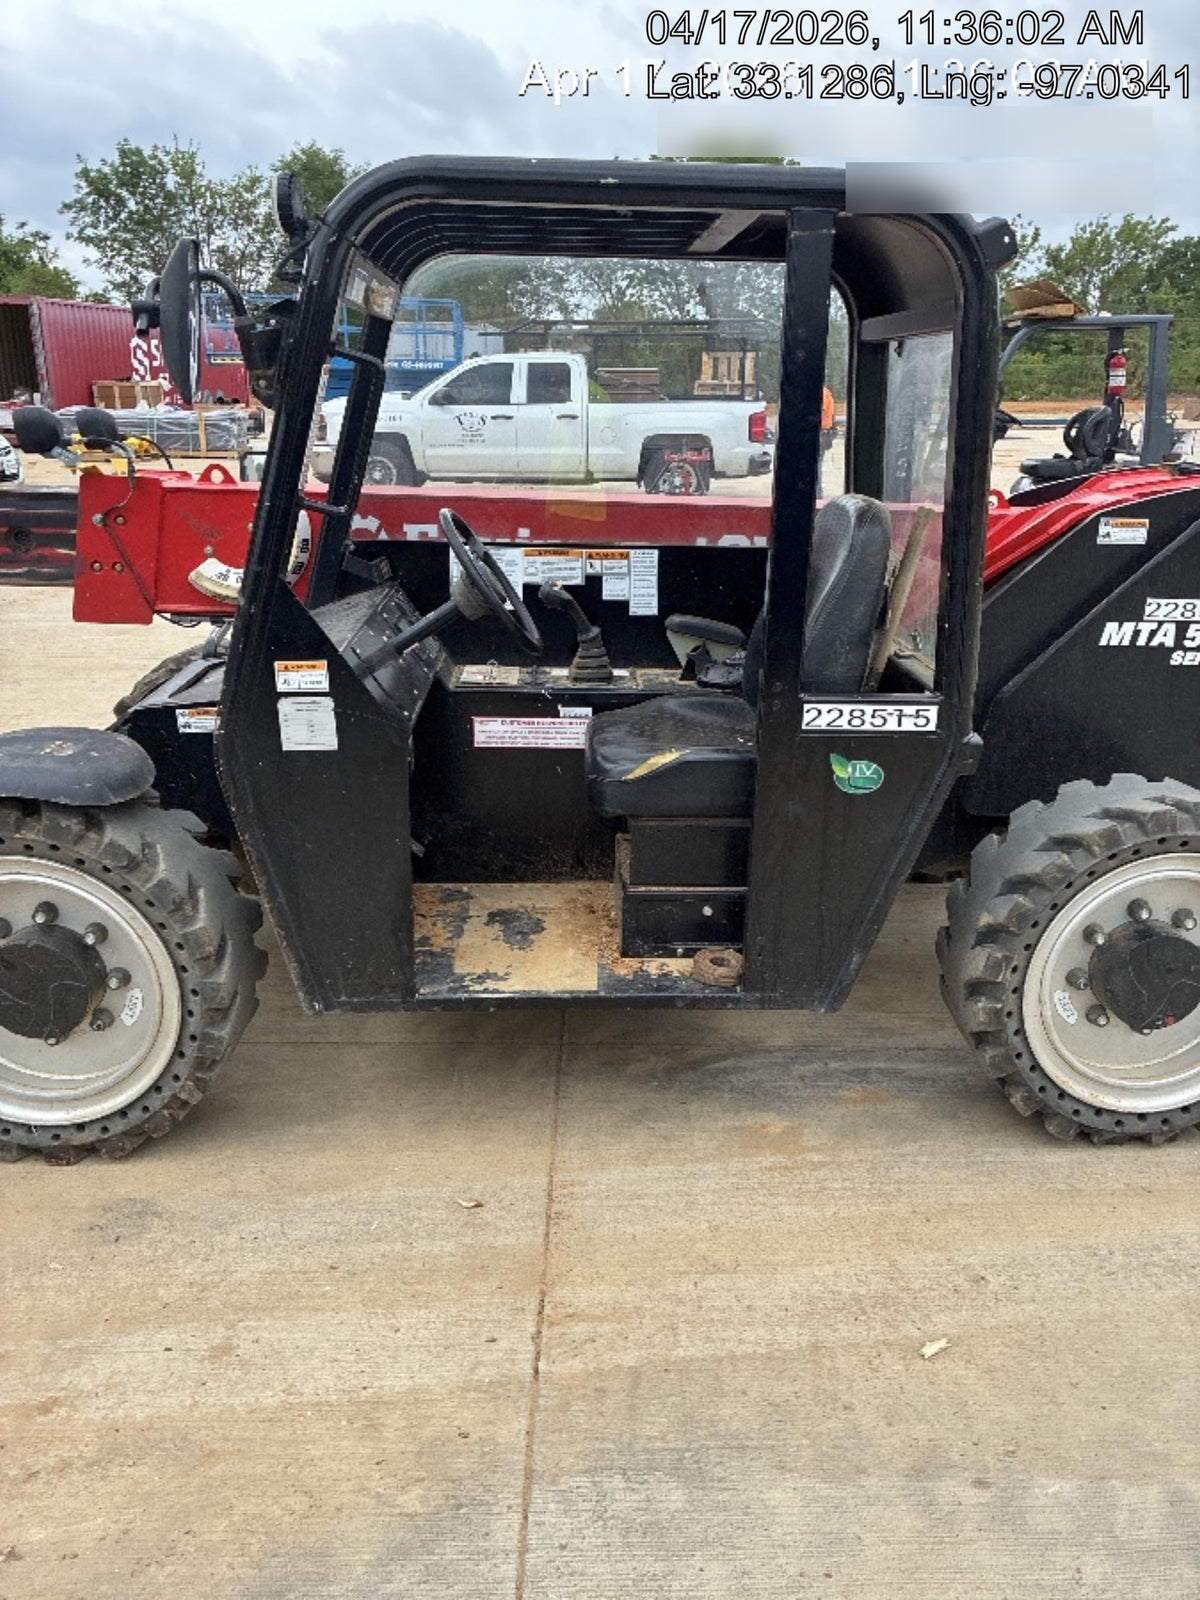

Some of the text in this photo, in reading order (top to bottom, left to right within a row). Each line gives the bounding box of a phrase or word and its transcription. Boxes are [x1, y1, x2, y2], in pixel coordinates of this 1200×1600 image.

[1145, 600, 1200, 619] 228
[1098, 621, 1177, 648] MTA
[803, 706, 931, 728] 228515
